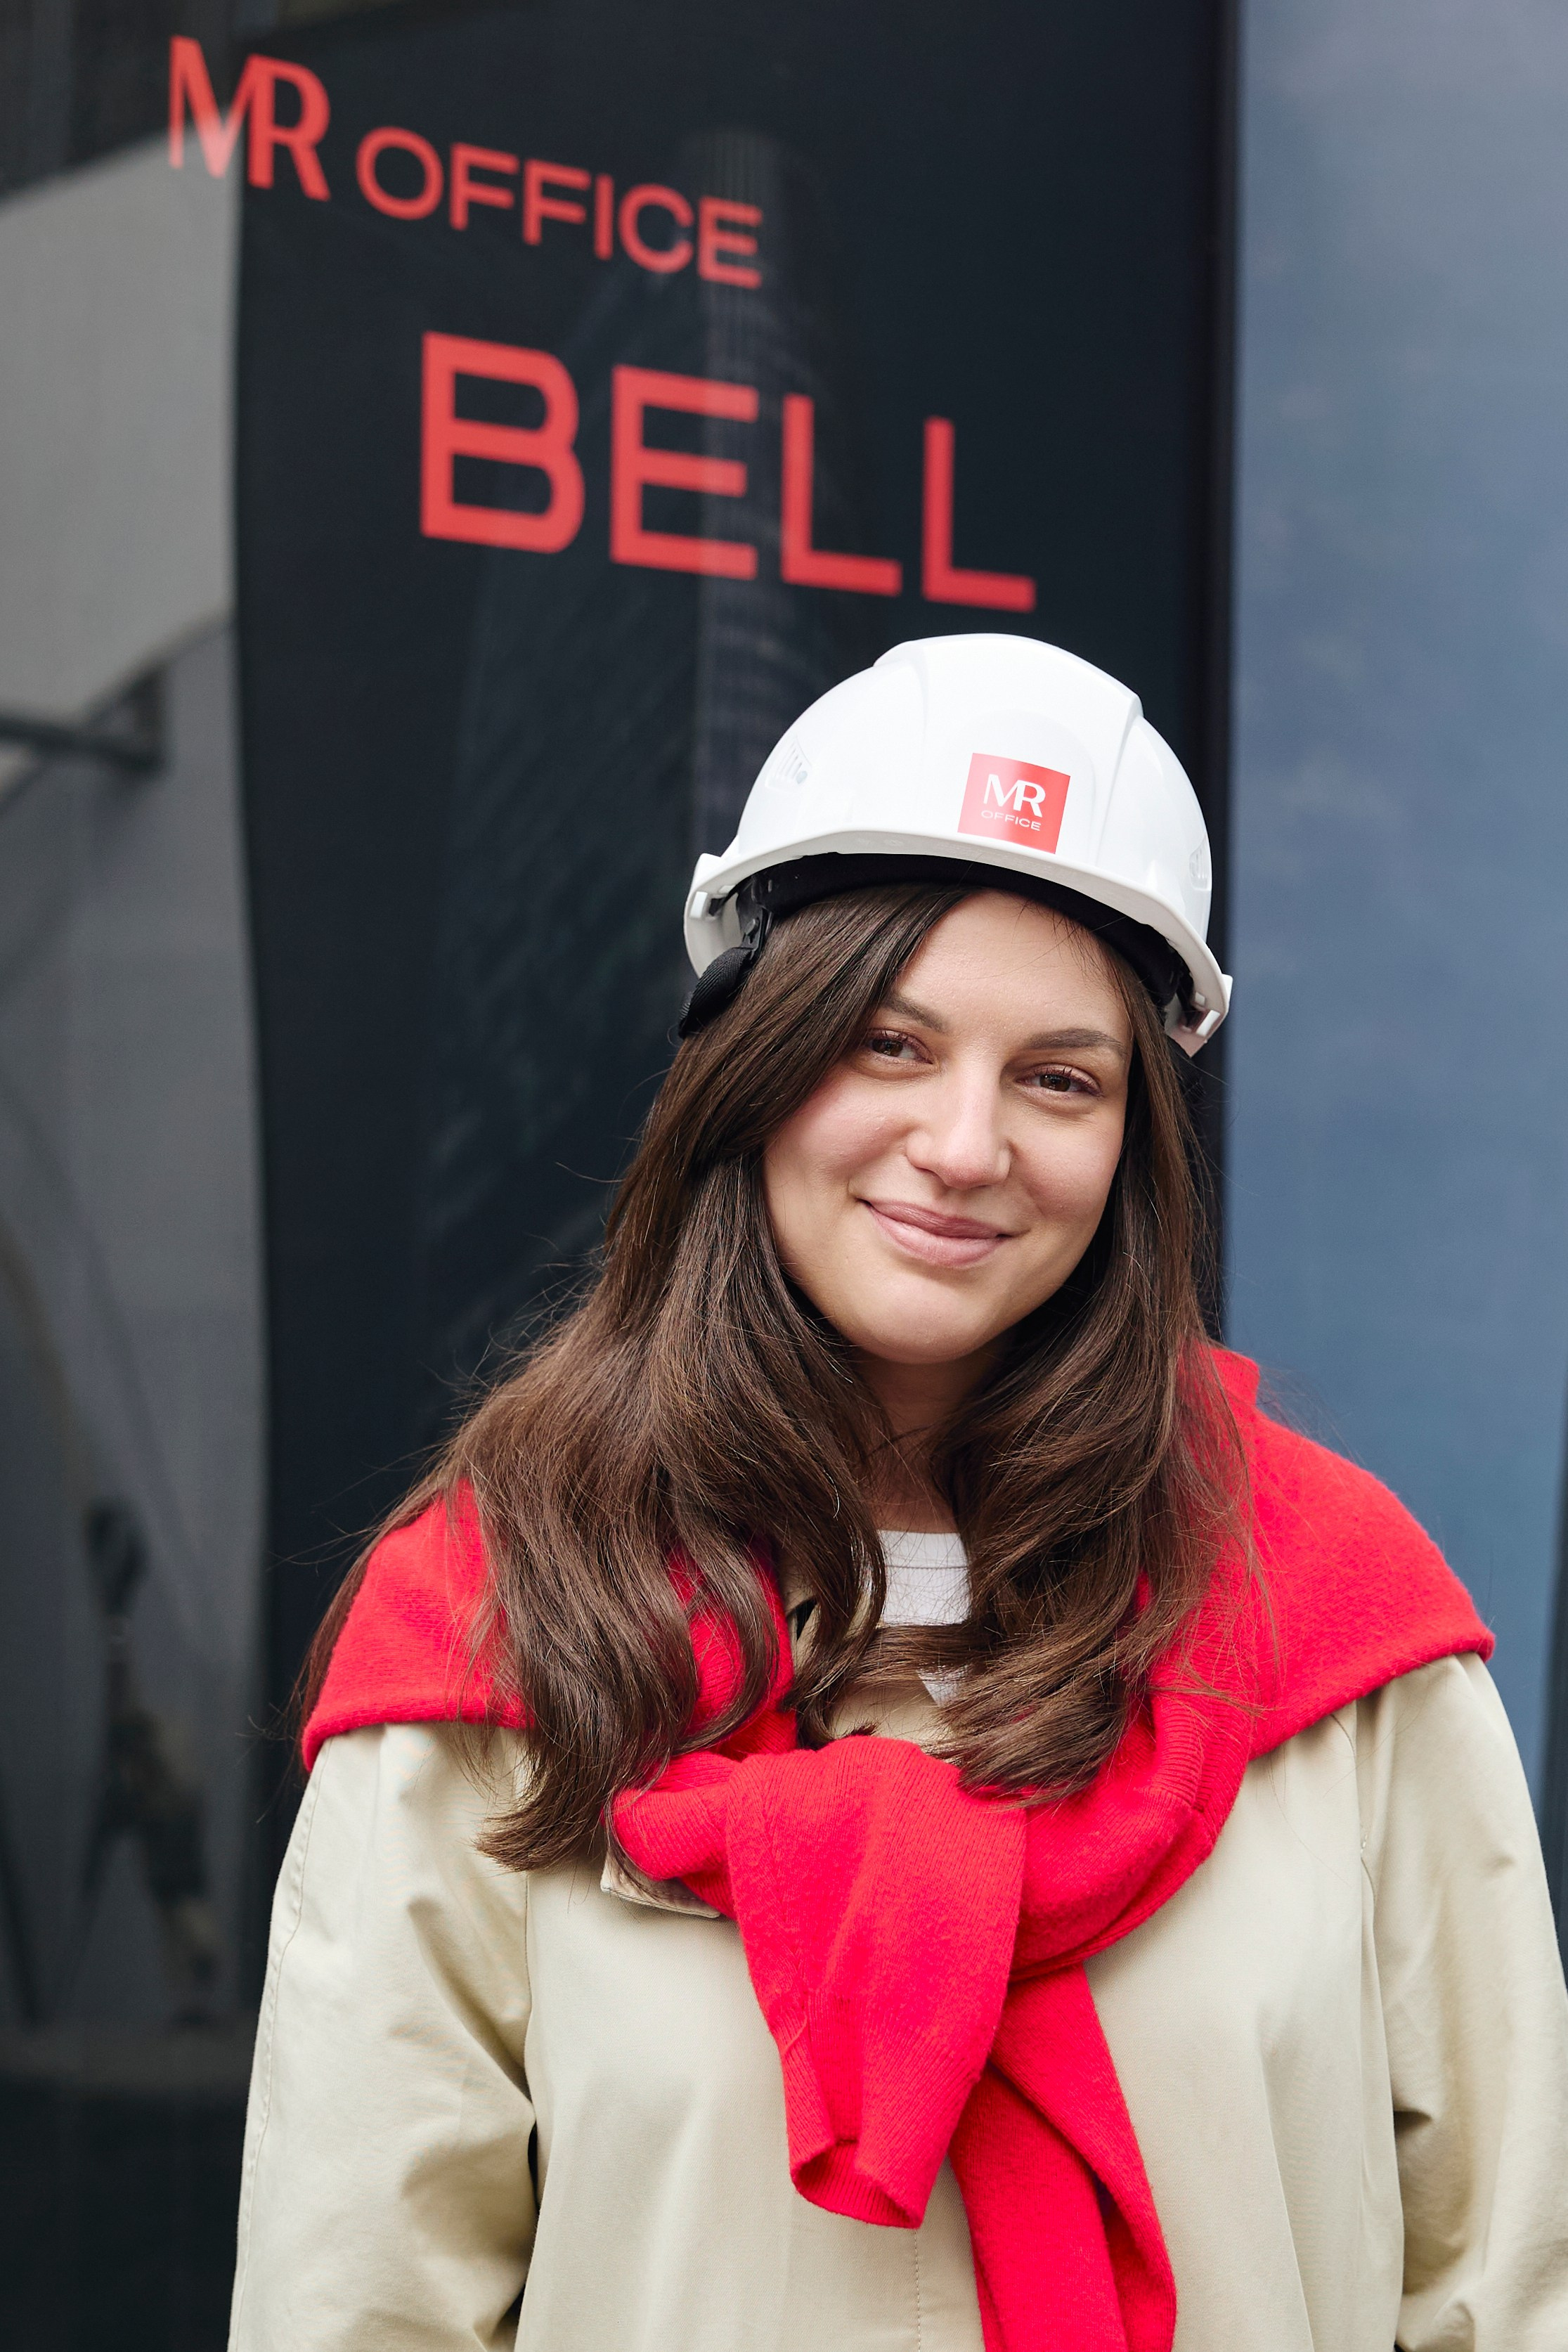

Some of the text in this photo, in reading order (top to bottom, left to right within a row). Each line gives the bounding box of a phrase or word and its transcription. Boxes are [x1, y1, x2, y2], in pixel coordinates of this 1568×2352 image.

[168, 36, 762, 288] MR OFFICE
[420, 331, 1036, 612] BELL
[981, 810, 1042, 832] OFFICE
[983, 774, 1046, 818] MR
